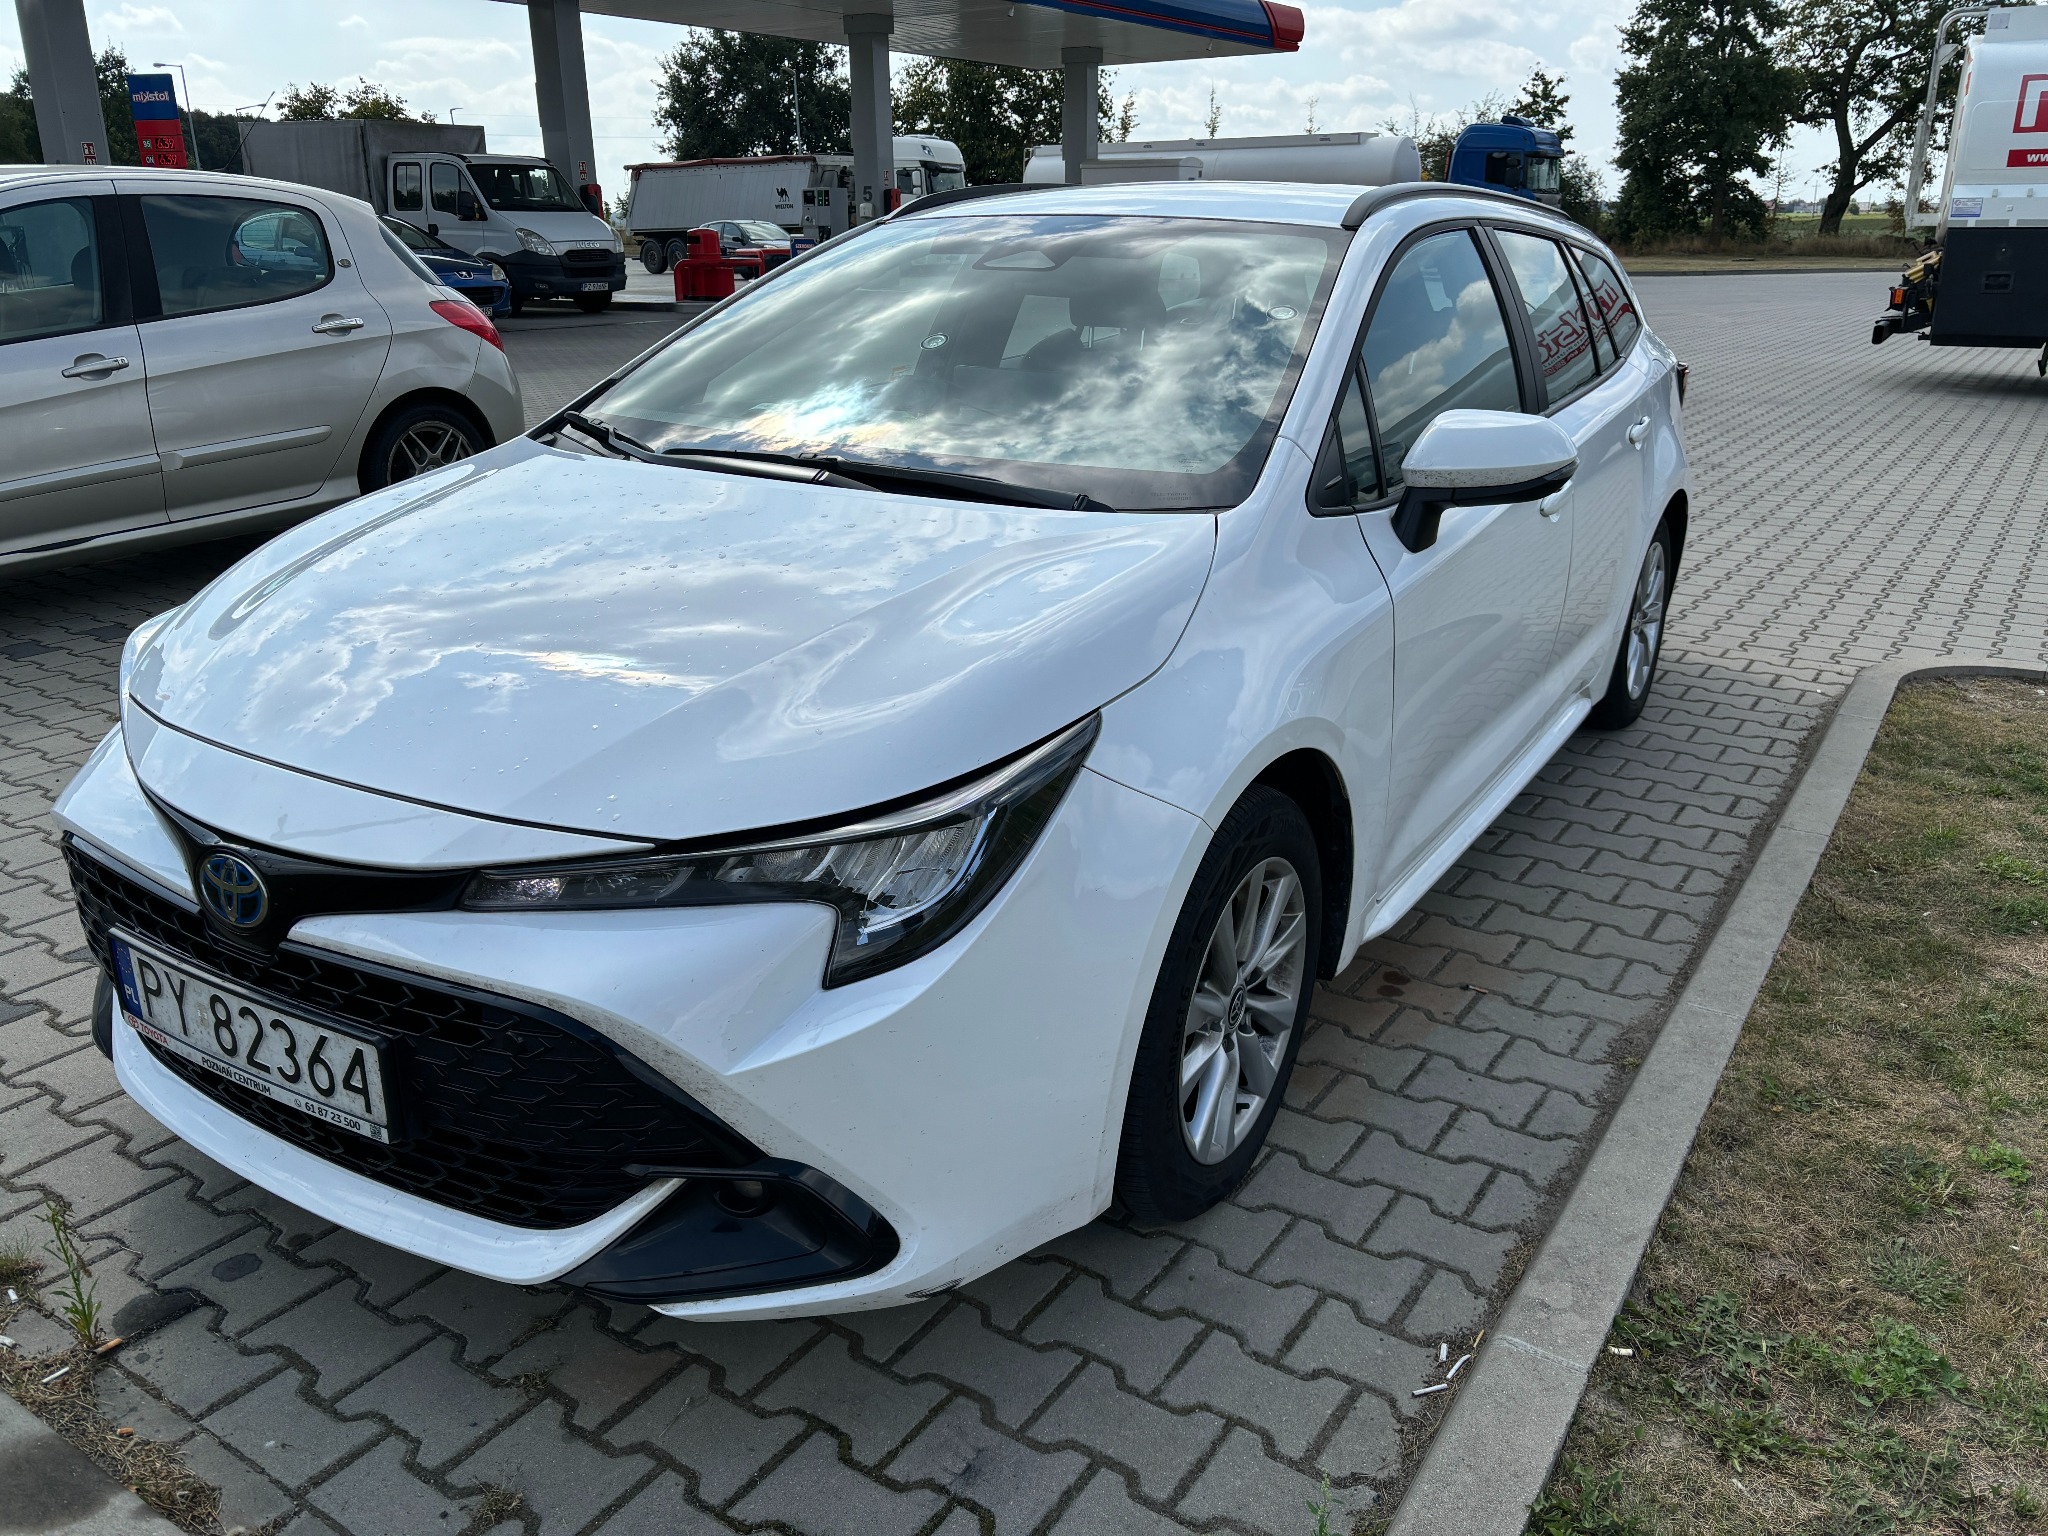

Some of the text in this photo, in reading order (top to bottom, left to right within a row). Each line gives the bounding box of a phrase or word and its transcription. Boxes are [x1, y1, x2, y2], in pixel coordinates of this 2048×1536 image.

[142, 140, 151, 148] 95
[145, 156, 154, 164] ON
[863, 185, 873, 202] 5
[576, 241, 600, 249] IVECO
[123, 983, 139, 1005] PL
[137, 956, 373, 1115] PY 82364
[140, 1022, 169, 1046] TOYOTA
[201, 1056, 272, 1096] POZNAŃ CENTRUM
[304, 1101, 361, 1131] 61 87 23 500
